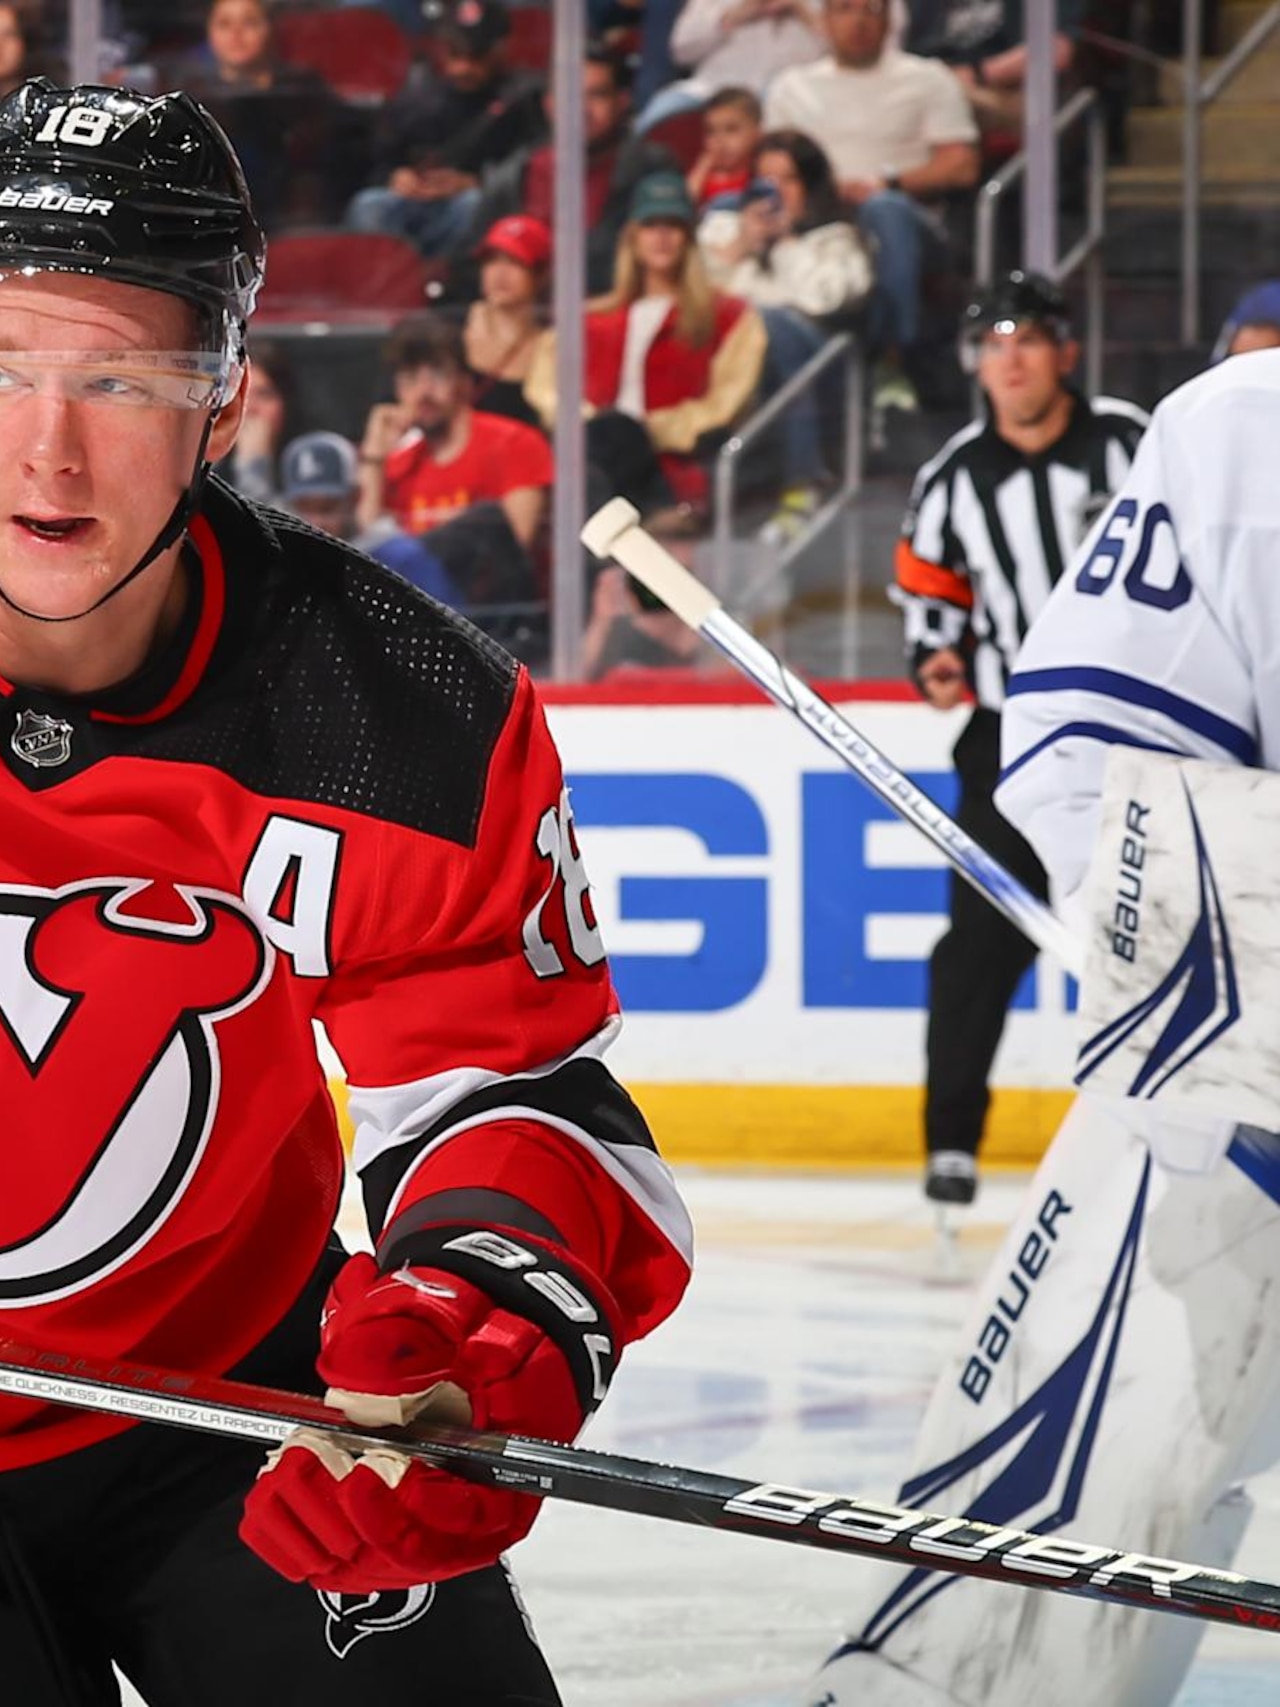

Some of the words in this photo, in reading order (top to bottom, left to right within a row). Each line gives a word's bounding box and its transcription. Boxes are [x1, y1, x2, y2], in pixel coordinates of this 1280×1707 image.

[35, 106, 114, 147] 18
[1075, 499, 1193, 612] 60
[243, 812, 342, 977] A
[563, 772, 1079, 1012] GE
[15, 1378, 98, 1402] QUICKNESS
[109, 1395, 199, 1422] RESSENTEZ
[200, 1411, 221, 1424] LA
